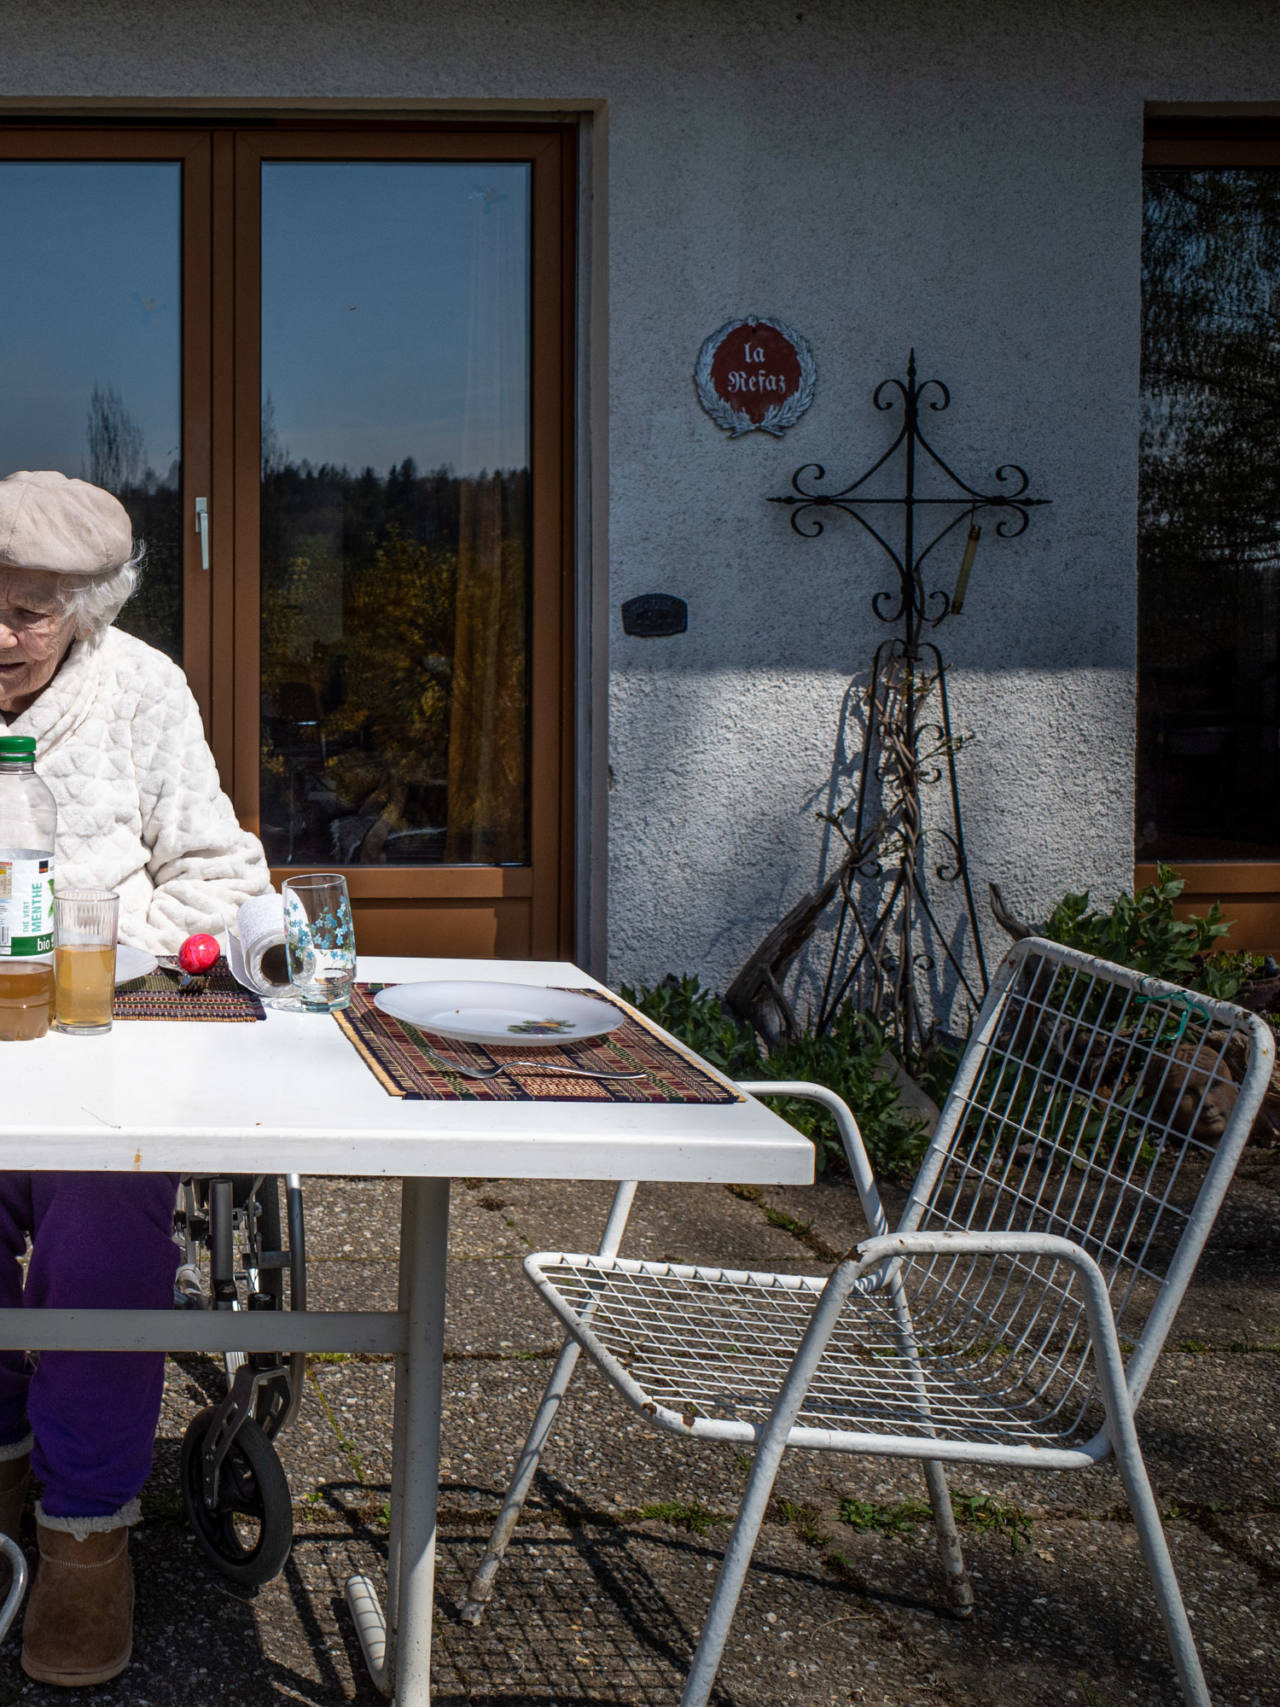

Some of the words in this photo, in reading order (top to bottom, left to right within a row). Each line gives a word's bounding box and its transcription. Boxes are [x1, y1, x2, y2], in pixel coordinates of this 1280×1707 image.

[744, 342, 766, 363] la
[32, 882, 43, 933] MENTHE
[37, 936, 50, 951] bio
